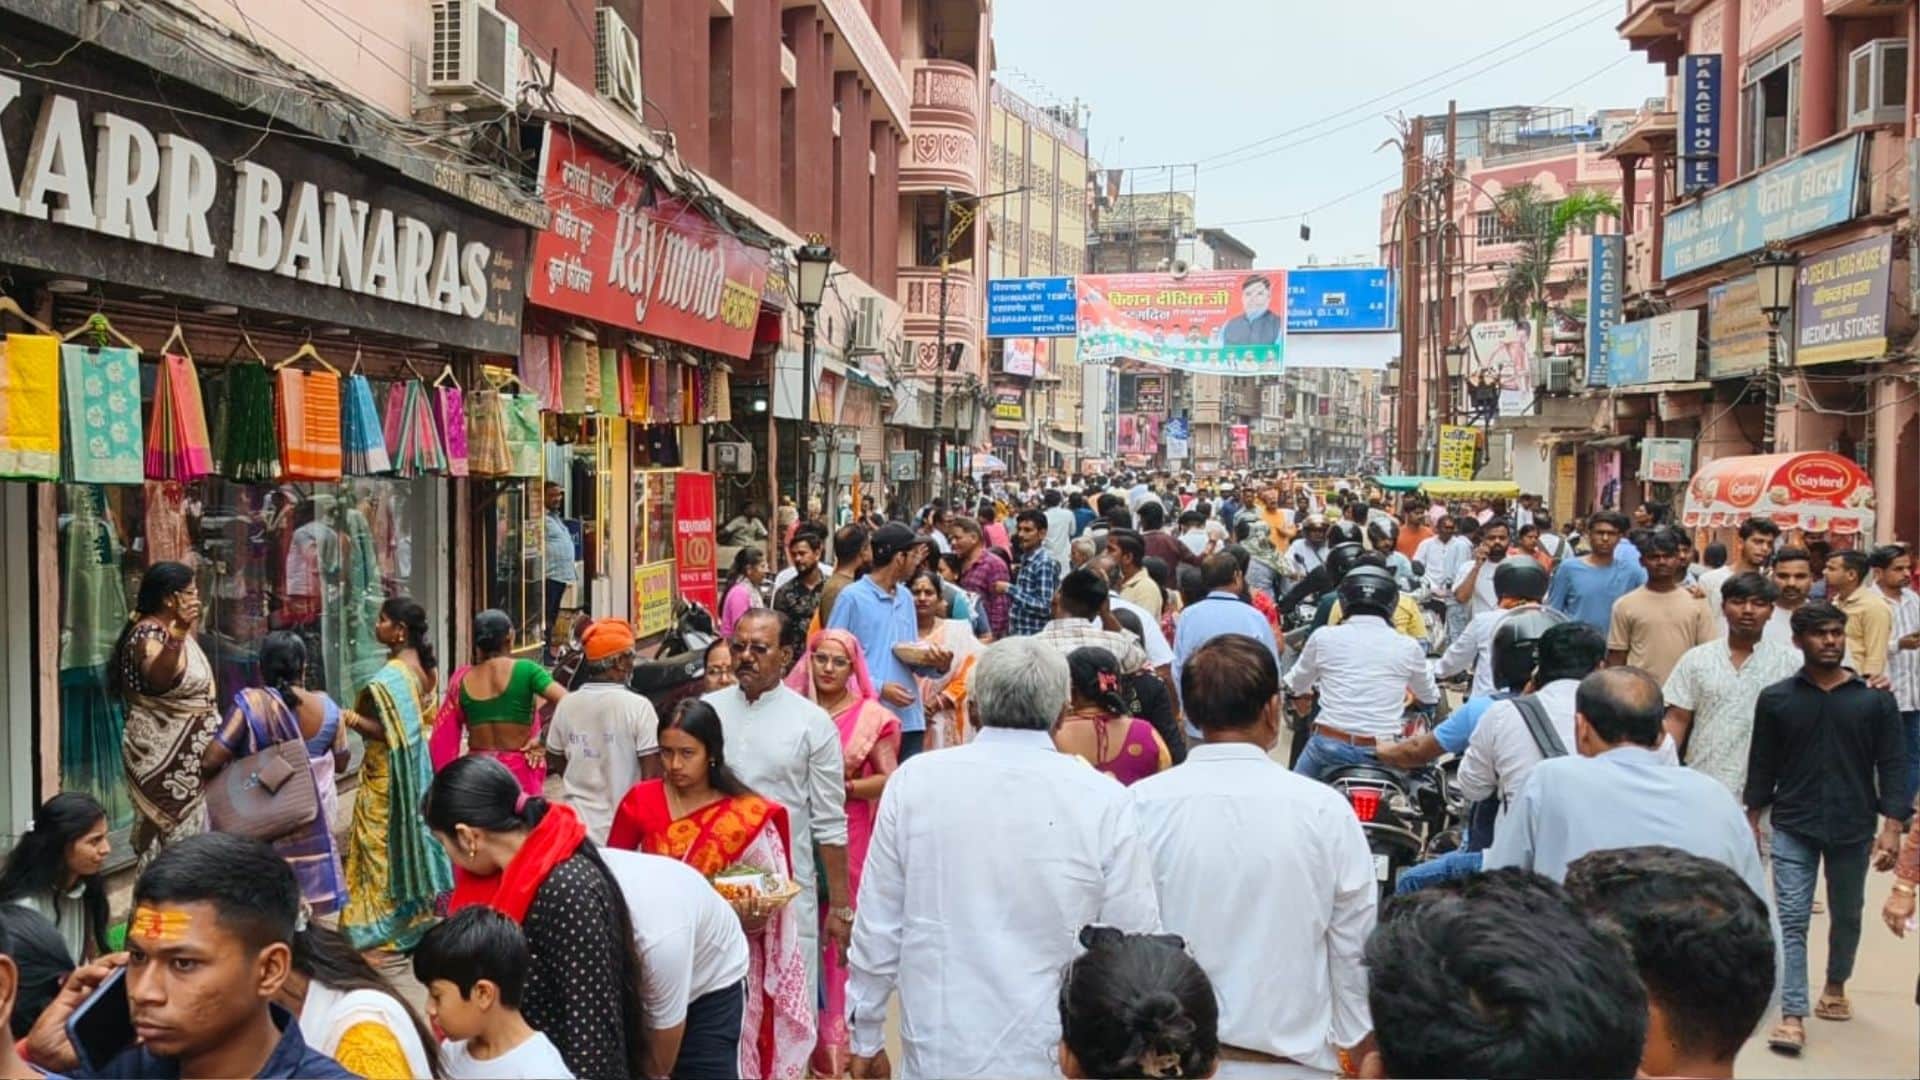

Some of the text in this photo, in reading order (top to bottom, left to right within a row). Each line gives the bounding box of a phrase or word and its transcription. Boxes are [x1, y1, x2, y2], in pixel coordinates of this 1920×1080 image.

[1695, 57, 1712, 123] PALACE
[228, 160, 490, 319] BANARAS
[608, 202, 726, 323] Raymond
[1601, 238, 1614, 304] PALACE
[1058, 314, 1075, 323] GHA
[1108, 290, 1150, 307] किशन
[1207, 289, 1229, 306] जी
[1801, 314, 1881, 345] MEDICAL STORE
